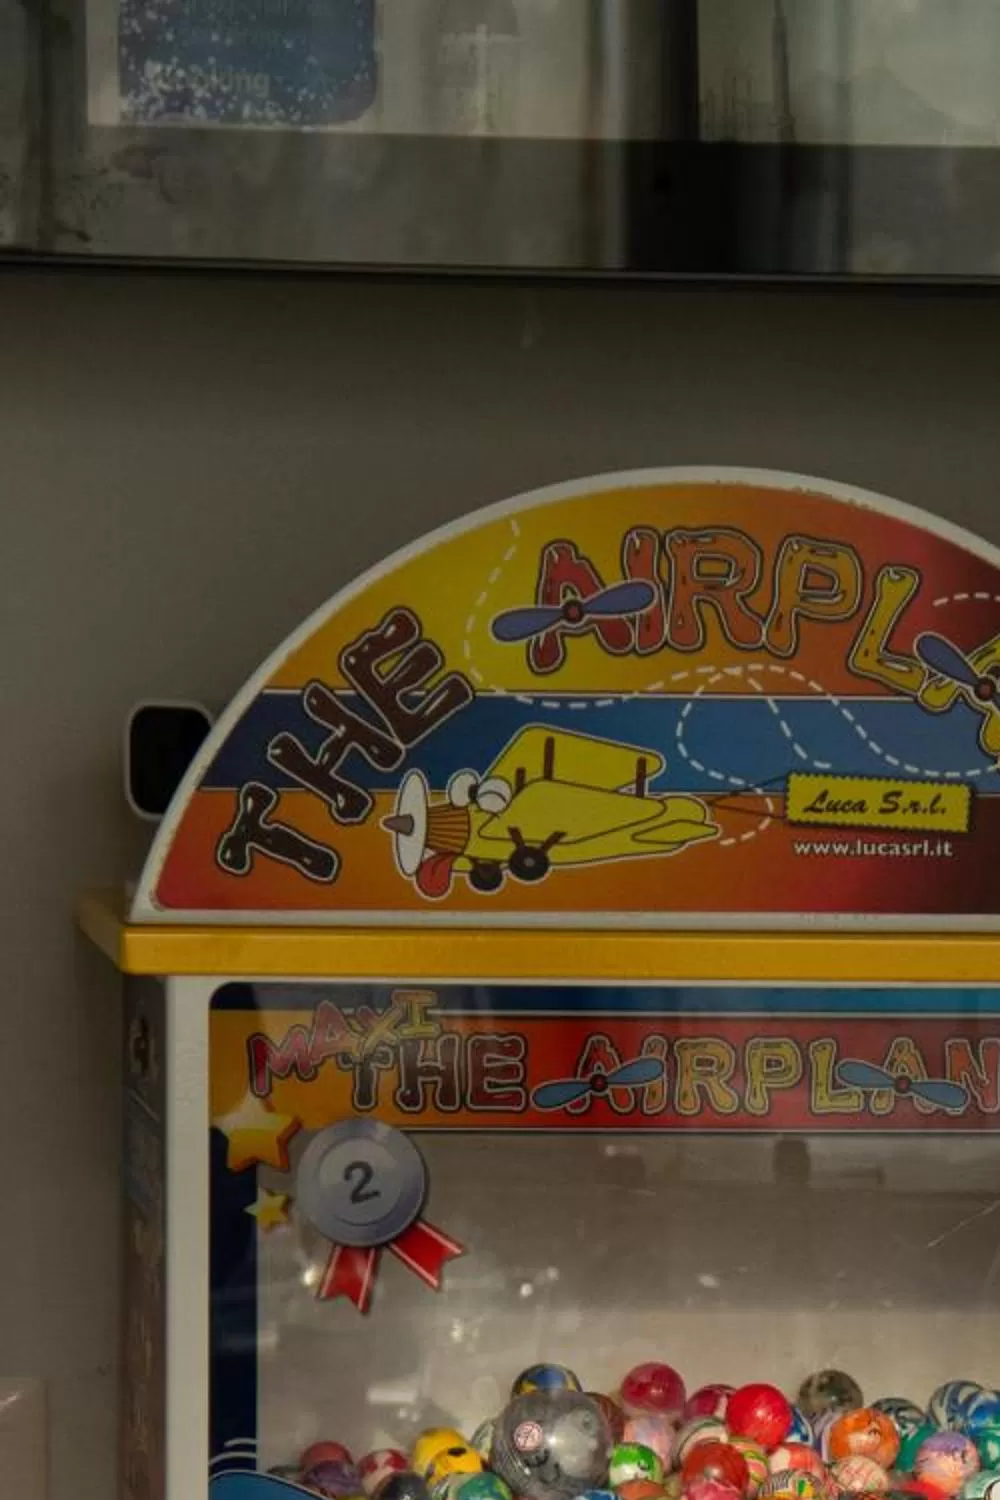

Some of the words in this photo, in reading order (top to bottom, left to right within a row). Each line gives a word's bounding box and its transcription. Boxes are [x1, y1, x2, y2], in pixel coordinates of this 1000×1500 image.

[215, 604, 476, 883] THE
[802, 789, 868, 816] Luca
[793, 838, 953, 858] www.lucasrl.it
[248, 988, 441, 1098] MAXI
[337, 1033, 526, 1112] THE
[343, 1161, 382, 1205] 2
